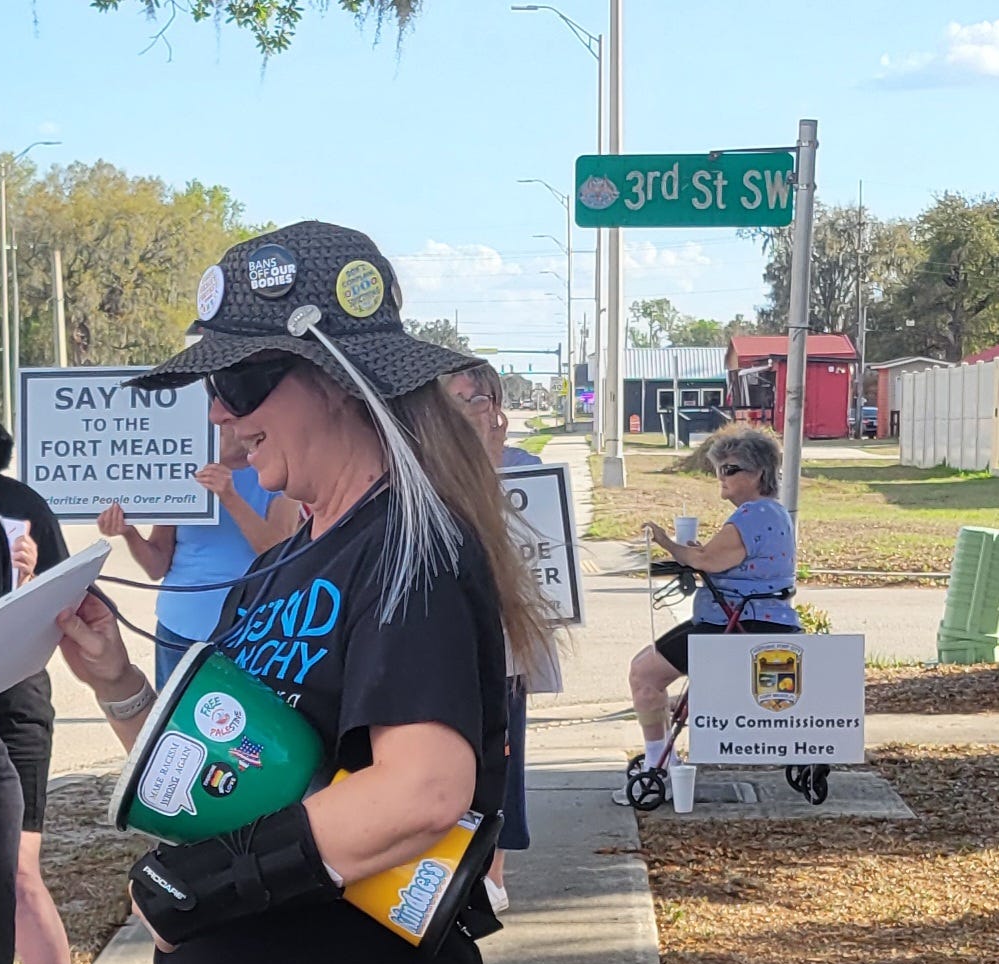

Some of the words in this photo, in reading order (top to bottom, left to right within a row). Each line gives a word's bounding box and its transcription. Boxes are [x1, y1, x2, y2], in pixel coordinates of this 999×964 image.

[624, 161, 679, 210] 3rd
[692, 170, 728, 210] St
[740, 170, 792, 210] SW
[249, 258, 277, 271] BANS
[249, 268, 270, 280] OFF
[271, 264, 296, 276] OUR
[251, 273, 293, 290] BODIES
[55, 386, 118, 410] SAY
[131, 387, 178, 409] NO
[82, 418, 106, 432] TO
[113, 417, 150, 431] THE
[41, 439, 102, 457] FORT
[110, 438, 193, 456] MEADE
[35, 464, 98, 482] DATA
[106, 462, 198, 480] CENTER
[46, 495, 89, 506] rioritize
[133, 495, 161, 505] Over
[164, 494, 196, 504] Profit
[200, 696, 223, 717] FREE
[209, 710, 242, 737] PALESTINE
[694, 715, 729, 731] City
[735, 715, 860, 729] Commissioners
[719, 742, 787, 756] Meeting
[795, 742, 835, 755] Here
[150, 776, 164, 800] MAKE
[159, 742, 180, 775] RACISM
[160, 776, 180, 807] WRONG
[178, 746, 192, 775] AGAIN
[142, 865, 187, 900] PROCARE
